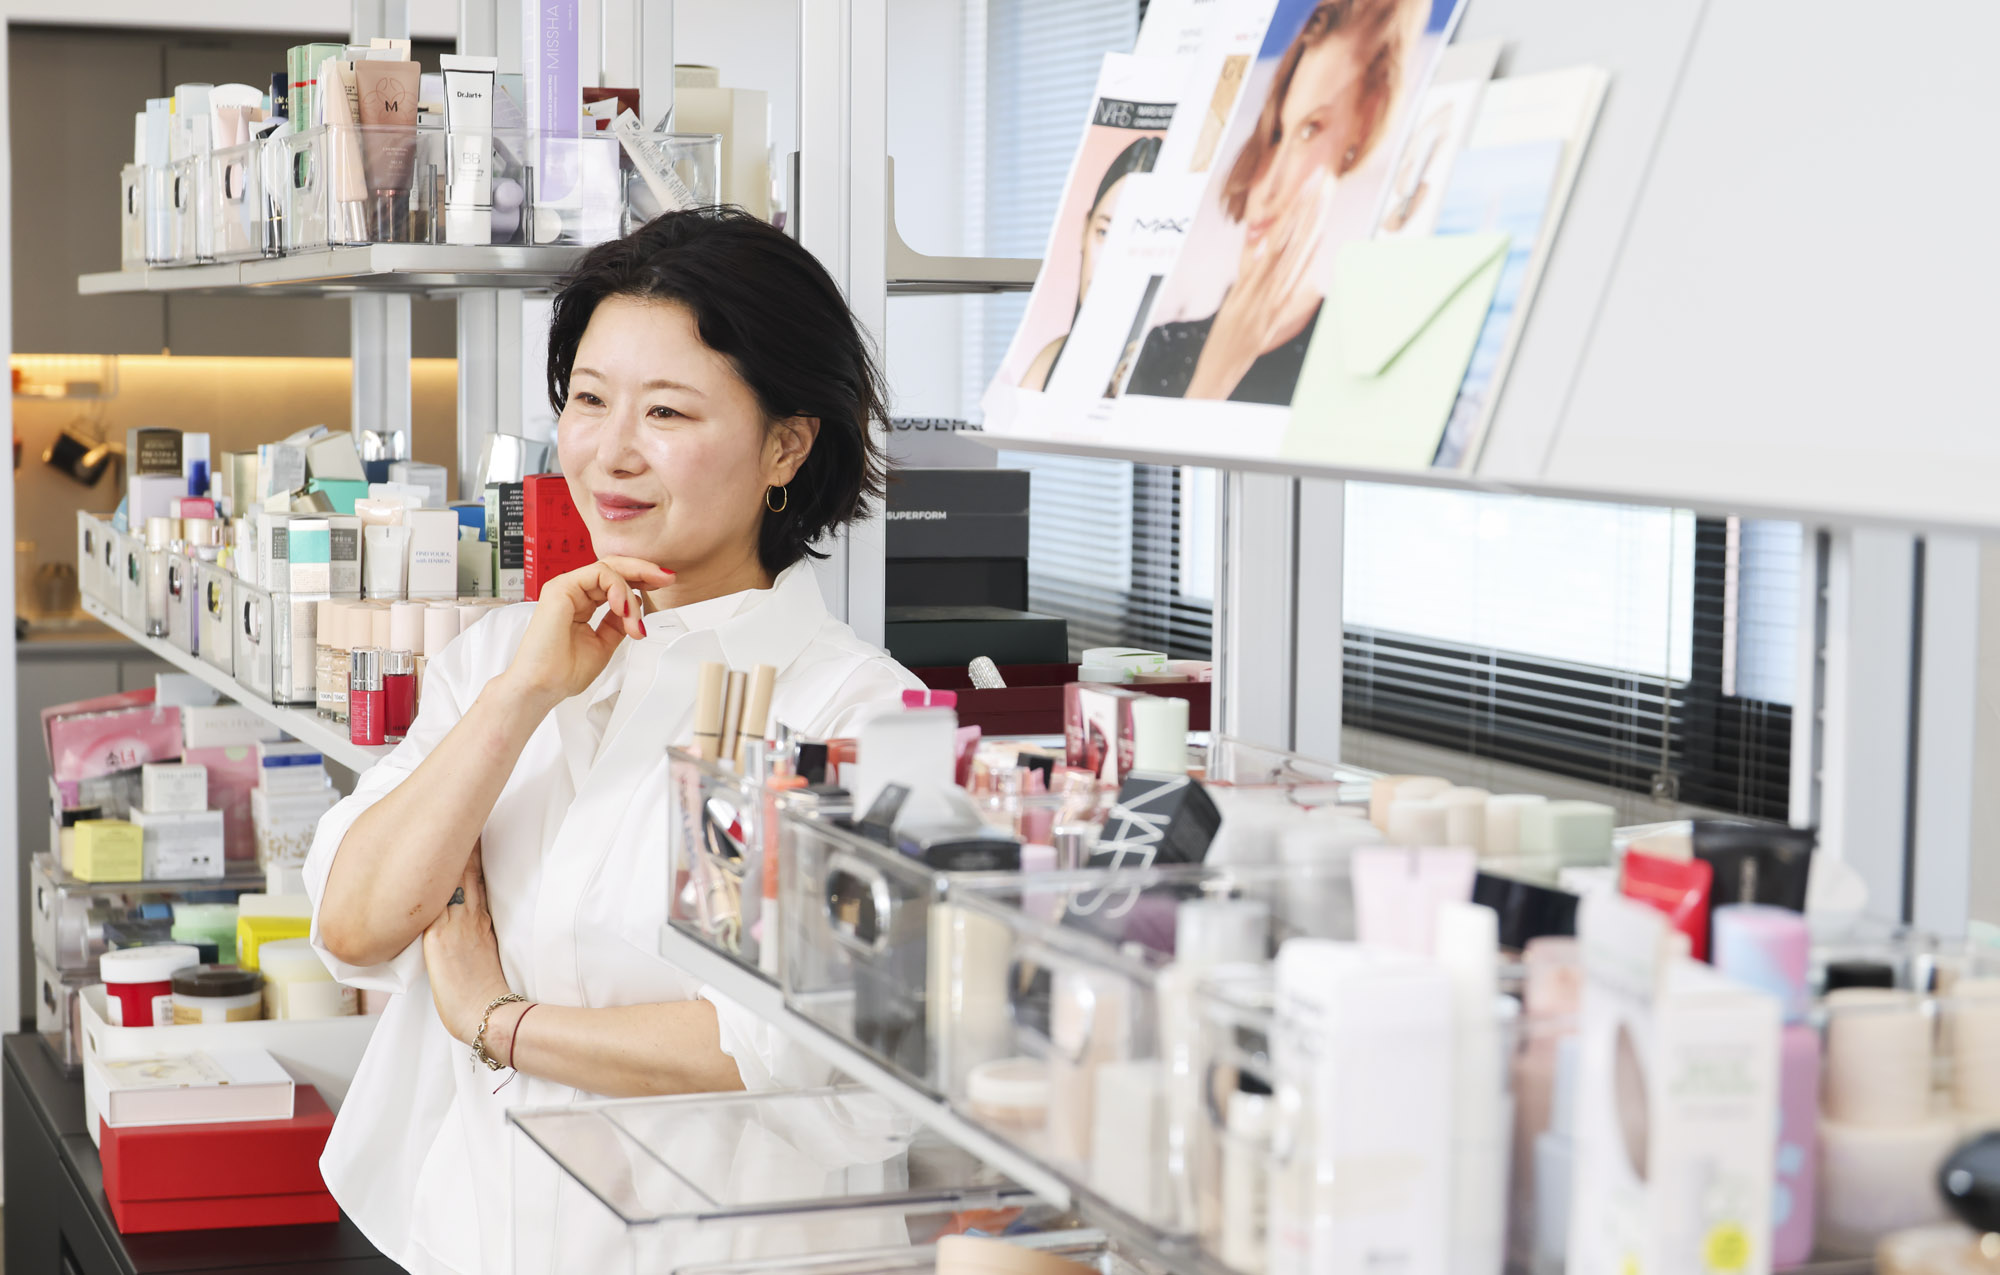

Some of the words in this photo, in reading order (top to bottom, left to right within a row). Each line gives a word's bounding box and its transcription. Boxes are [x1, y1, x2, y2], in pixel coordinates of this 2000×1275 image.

[546, 4, 560, 69] MISSHA
[456, 91, 482, 99] Dr.Jart+
[385, 101, 398, 113] M
[1092, 98, 1135, 127] NARS
[886, 511, 947, 520] SUPERFORM
[105, 748, 136, 768] 소녀
[1067, 770, 1190, 920] NARS
